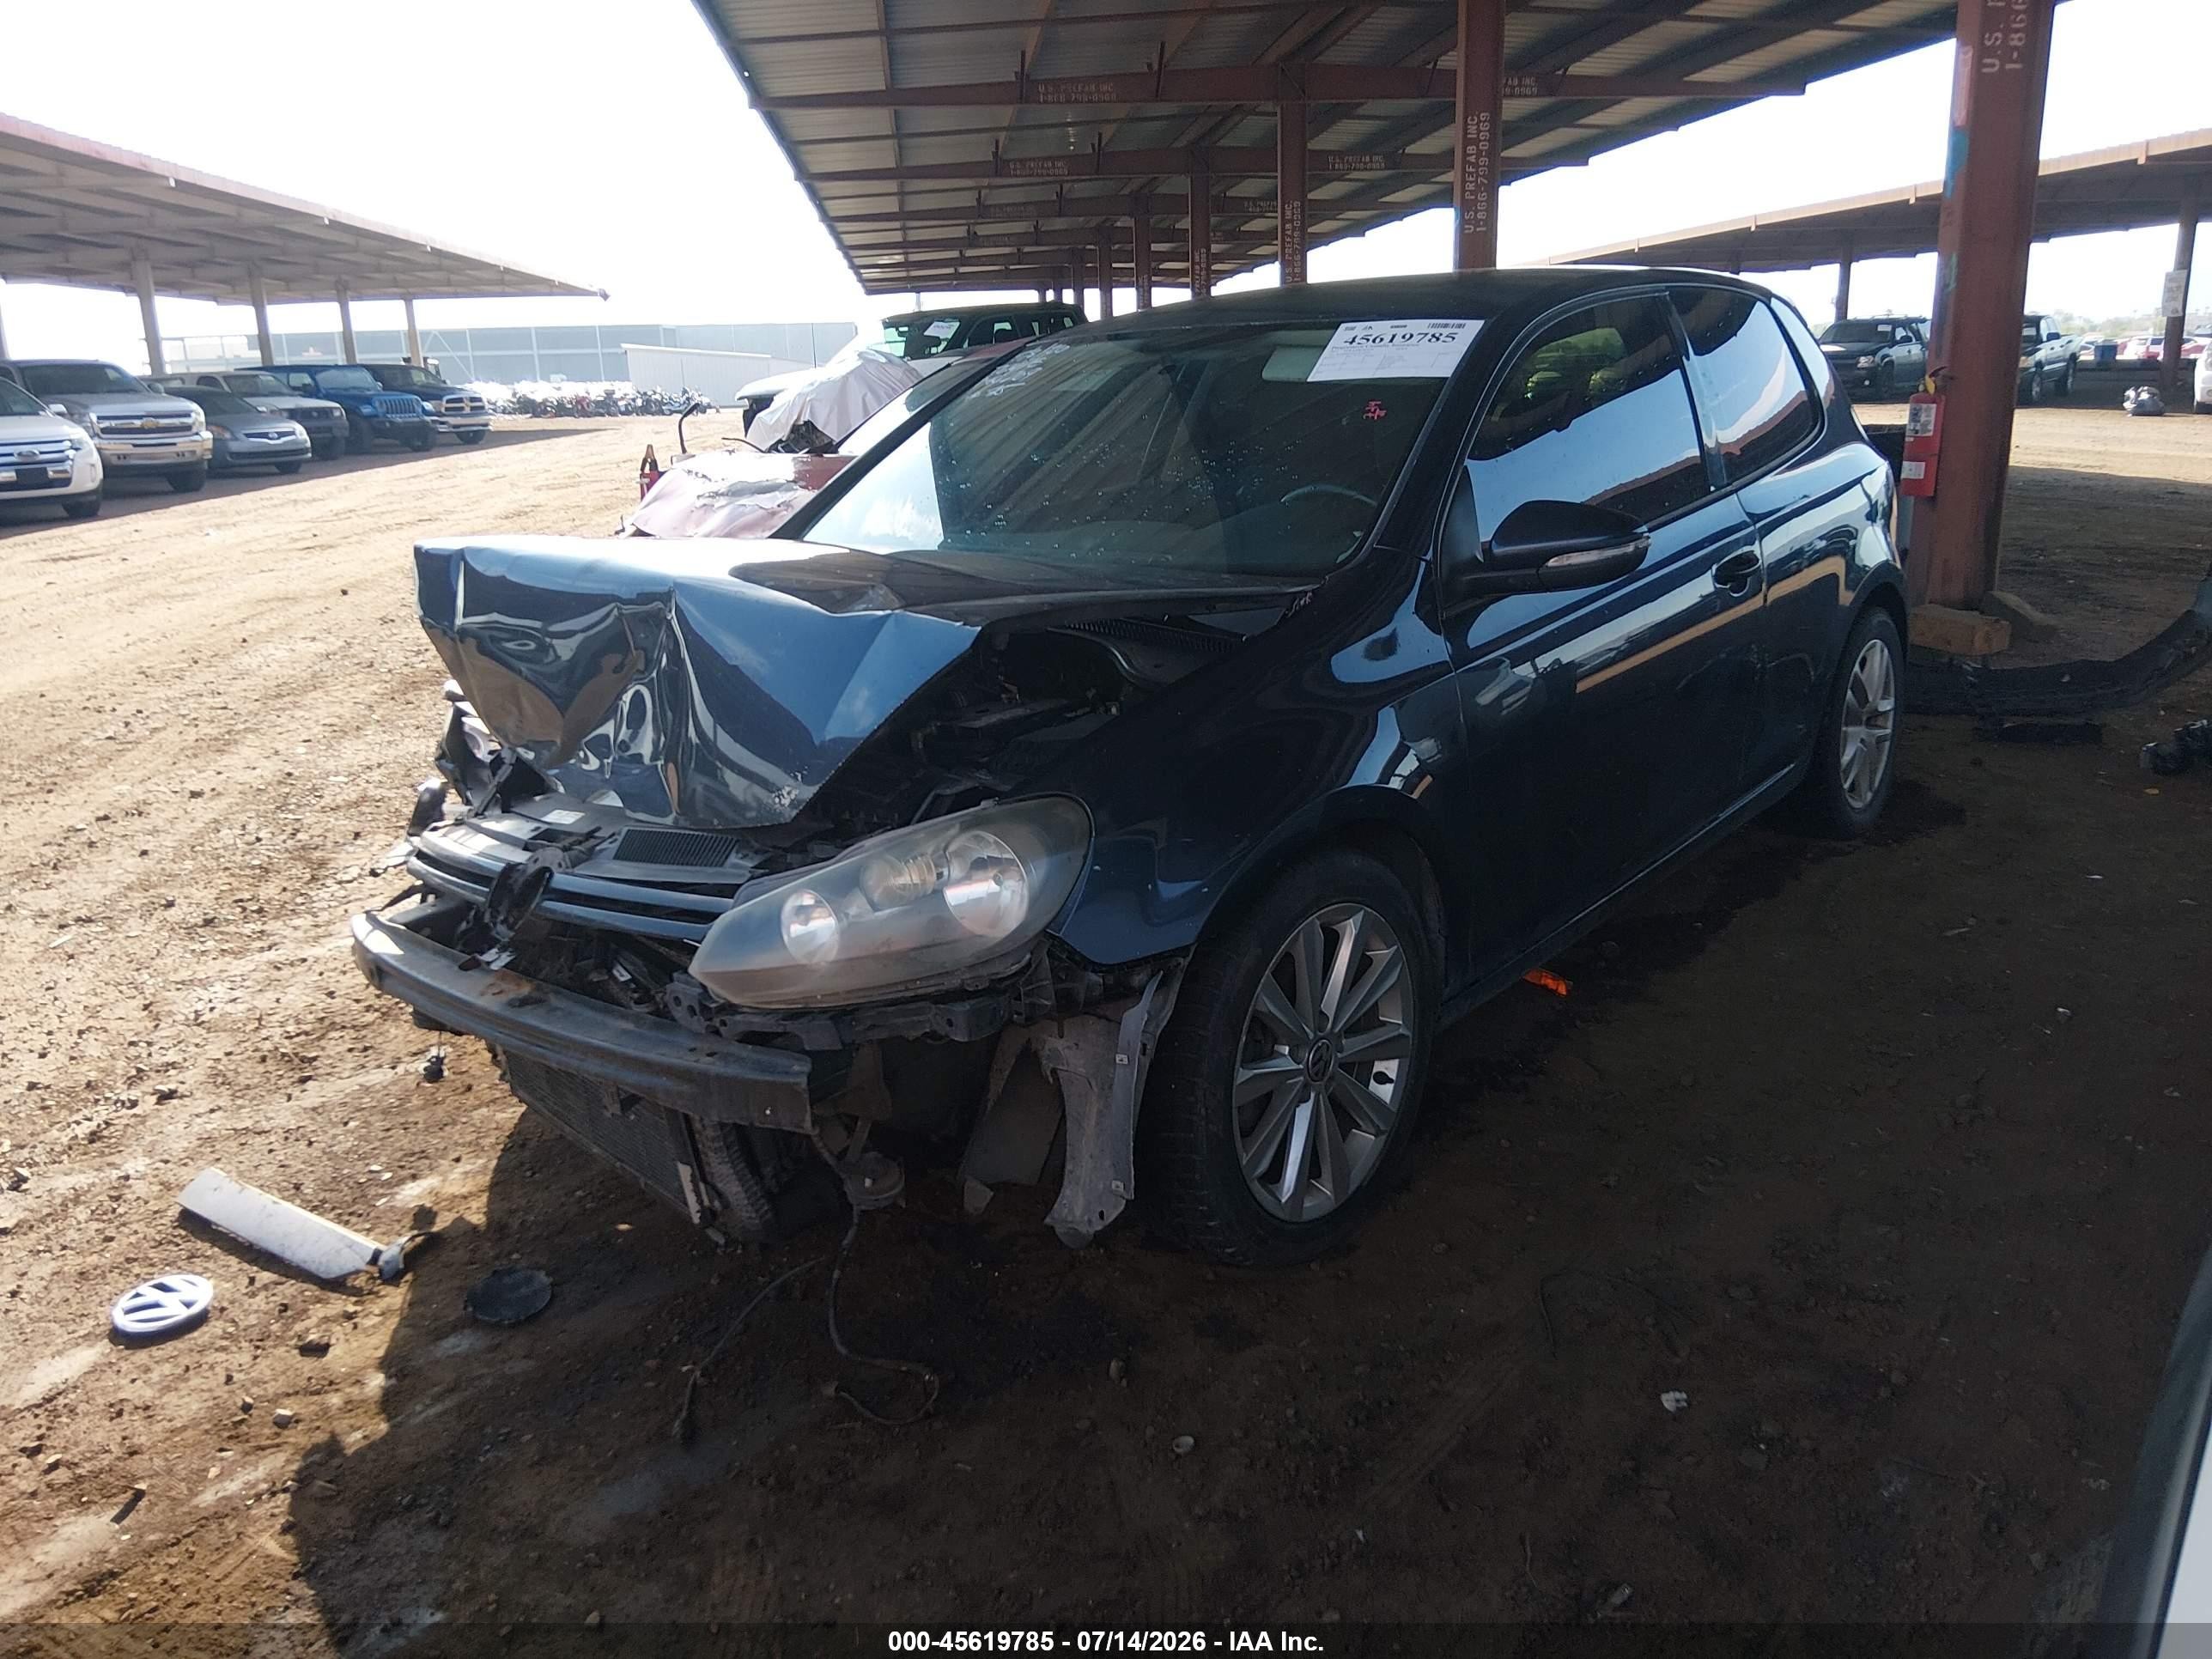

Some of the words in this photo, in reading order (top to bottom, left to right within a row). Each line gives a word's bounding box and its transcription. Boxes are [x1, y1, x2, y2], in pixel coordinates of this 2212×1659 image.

[1982, 22, 2004, 73] U.S.
[1467, 111, 1478, 138] INC.
[1464, 144, 1477, 199] PREFAB
[1476, 112, 1491, 232] 1-866-799-0969
[1463, 206, 1475, 234] U.S.
[1343, 331, 1459, 345] 45619785
